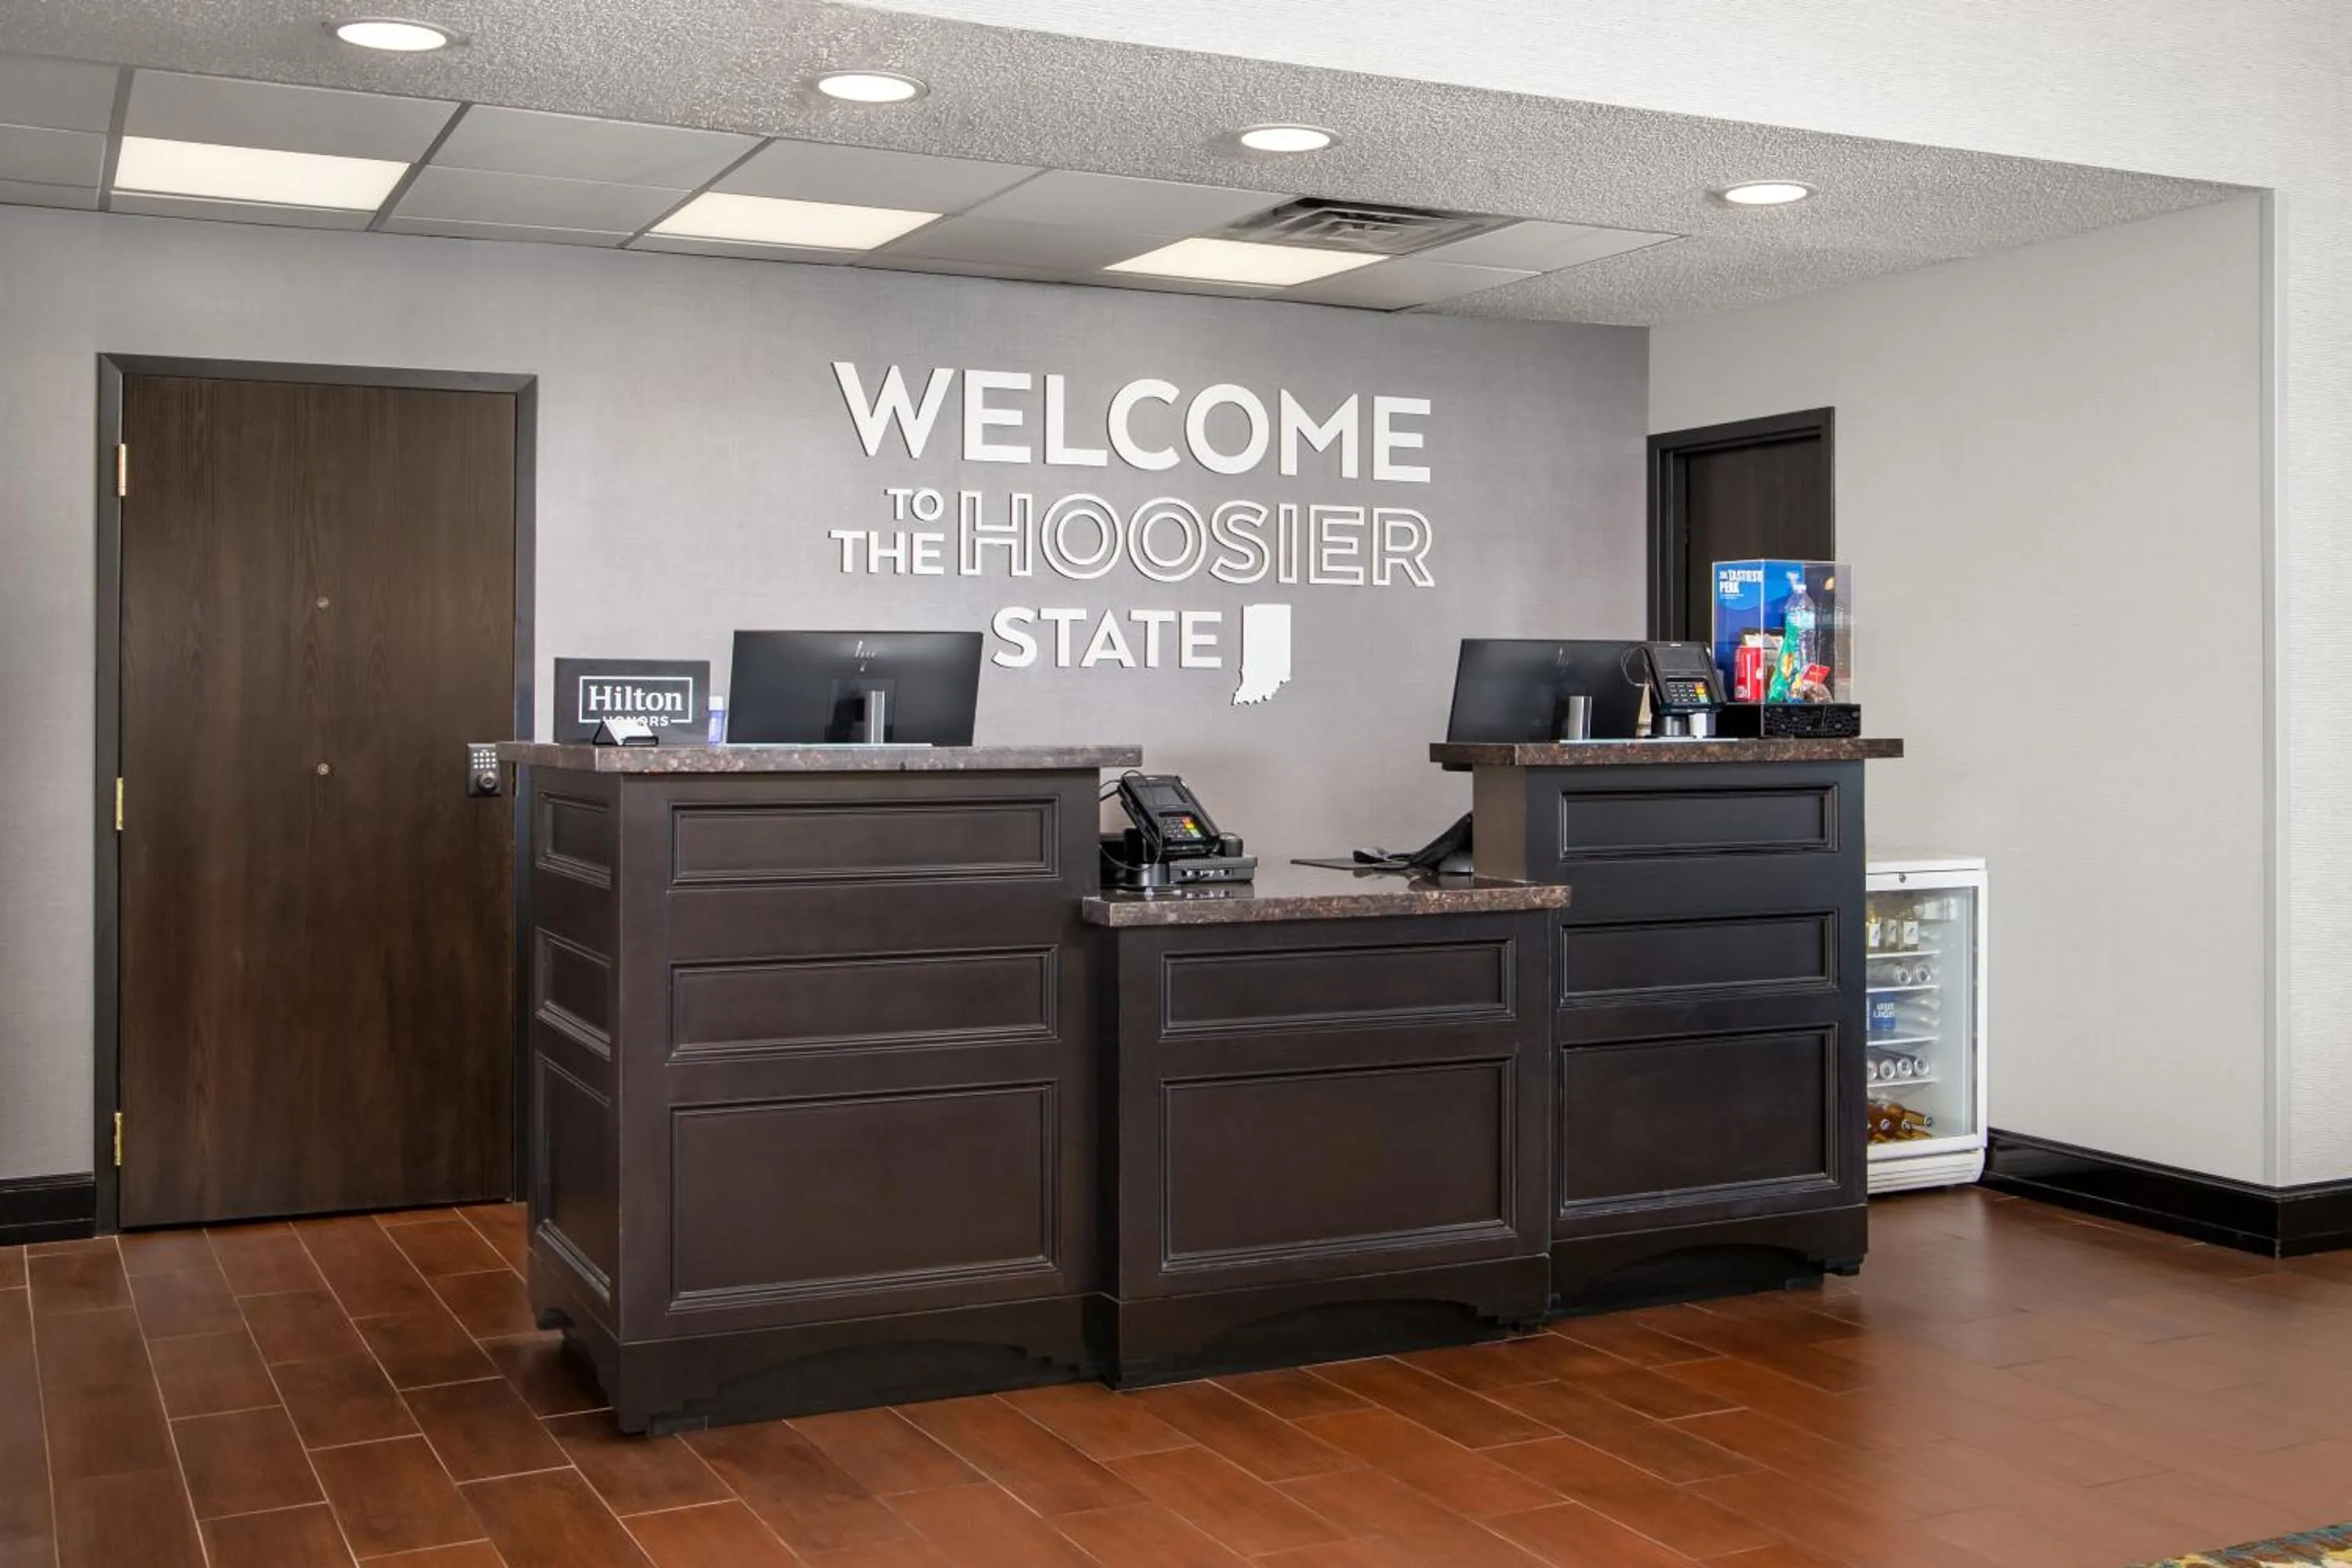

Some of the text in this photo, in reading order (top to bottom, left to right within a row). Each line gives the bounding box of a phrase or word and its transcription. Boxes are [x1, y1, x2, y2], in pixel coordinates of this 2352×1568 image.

[833, 361, 1431, 483] WELCOME
[886, 487, 945, 523] TO
[829, 489, 1436, 588] THE HOOSIER
[992, 606, 1223, 669] STATE
[589, 686, 684, 711] Hilton
